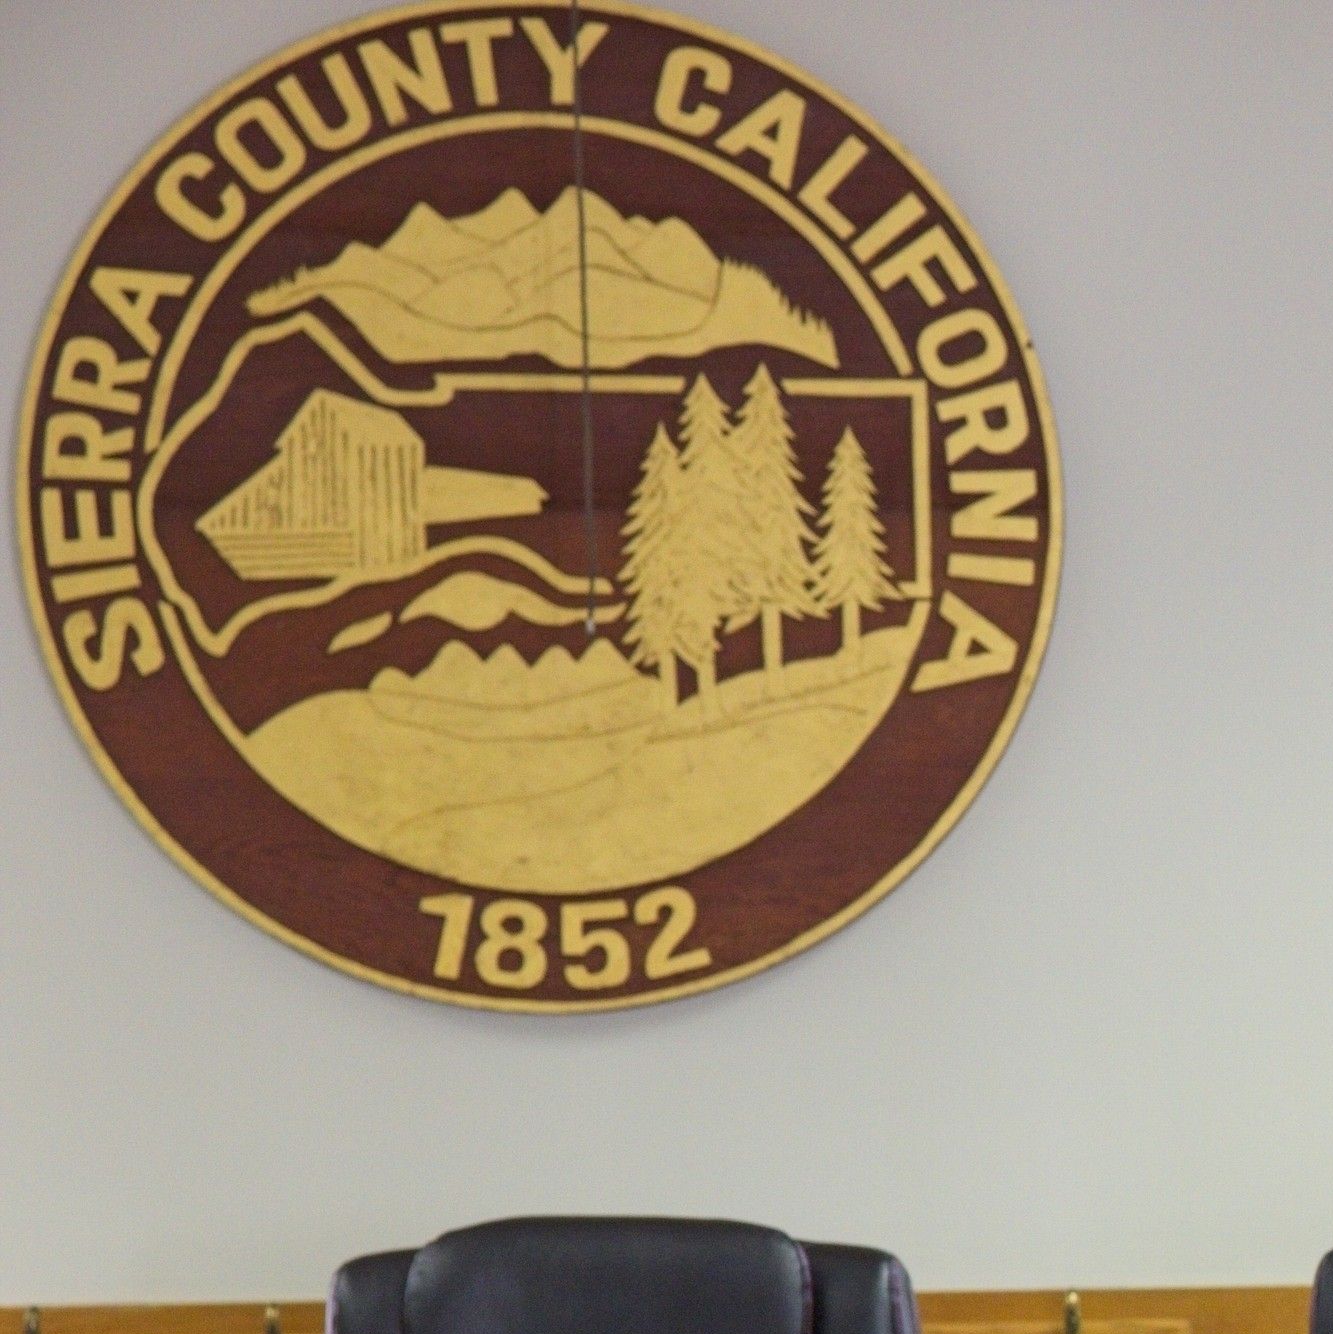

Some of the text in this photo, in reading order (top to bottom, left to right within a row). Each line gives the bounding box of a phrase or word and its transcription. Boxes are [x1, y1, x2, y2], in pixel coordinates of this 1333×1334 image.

[41, 17, 1041, 692] SIERRA COUNTY CALIFORNIA
[419, 885, 712, 990] 1852
